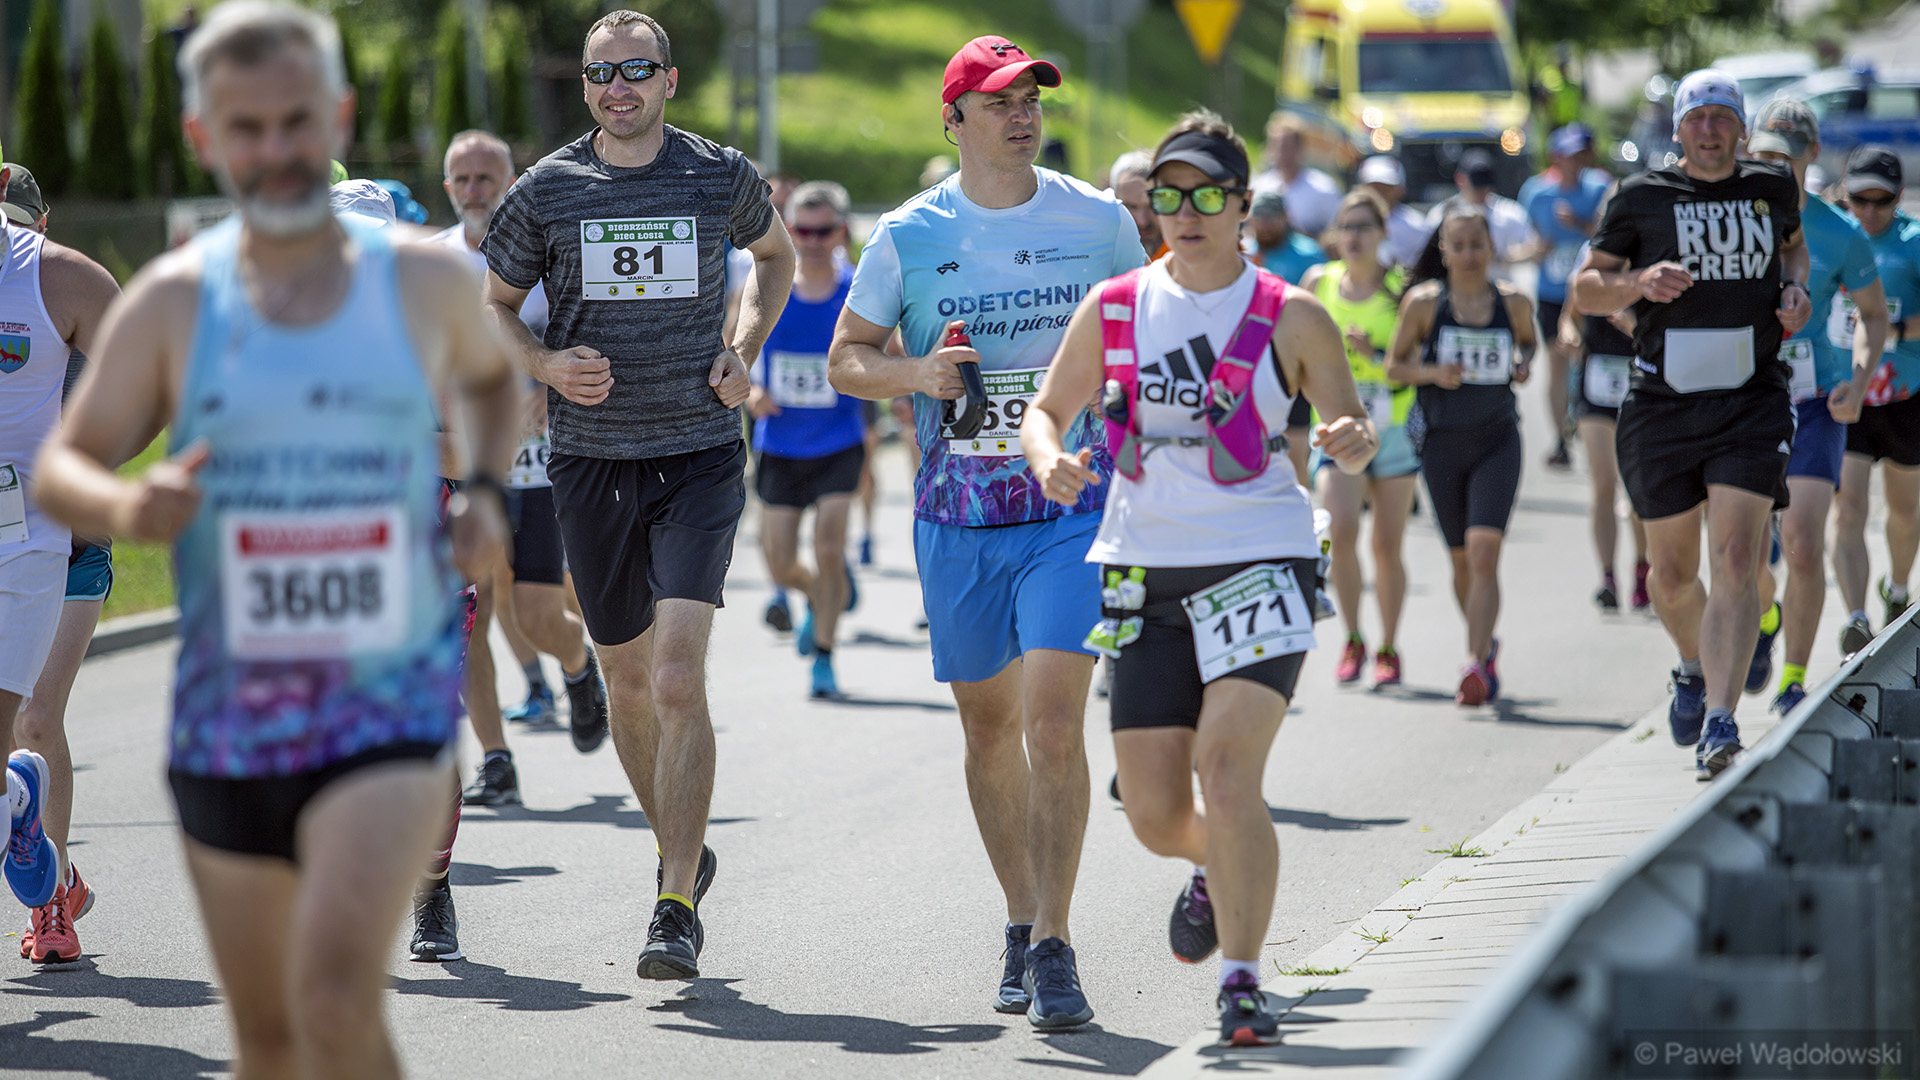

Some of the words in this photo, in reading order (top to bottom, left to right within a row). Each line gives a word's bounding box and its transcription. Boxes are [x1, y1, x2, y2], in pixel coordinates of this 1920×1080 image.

[1673, 200, 1755, 220] MEDYK
[608, 222, 669, 232] BIEBRZAŃSKI
[613, 232, 636, 240] BIEG
[637, 231, 664, 240] ŁOSIA
[1675, 215, 1774, 256] RUN
[612, 245, 664, 276] 81
[1680, 252, 1772, 280] CREW
[937, 283, 1092, 317] ODETCHNIJ
[960, 314, 1010, 338] ełną
[983, 374, 1030, 384] BRZAŃSKI
[997, 384, 1025, 393] ŁOSIA
[248, 565, 384, 626] 3608
[1213, 595, 1292, 645] 171
